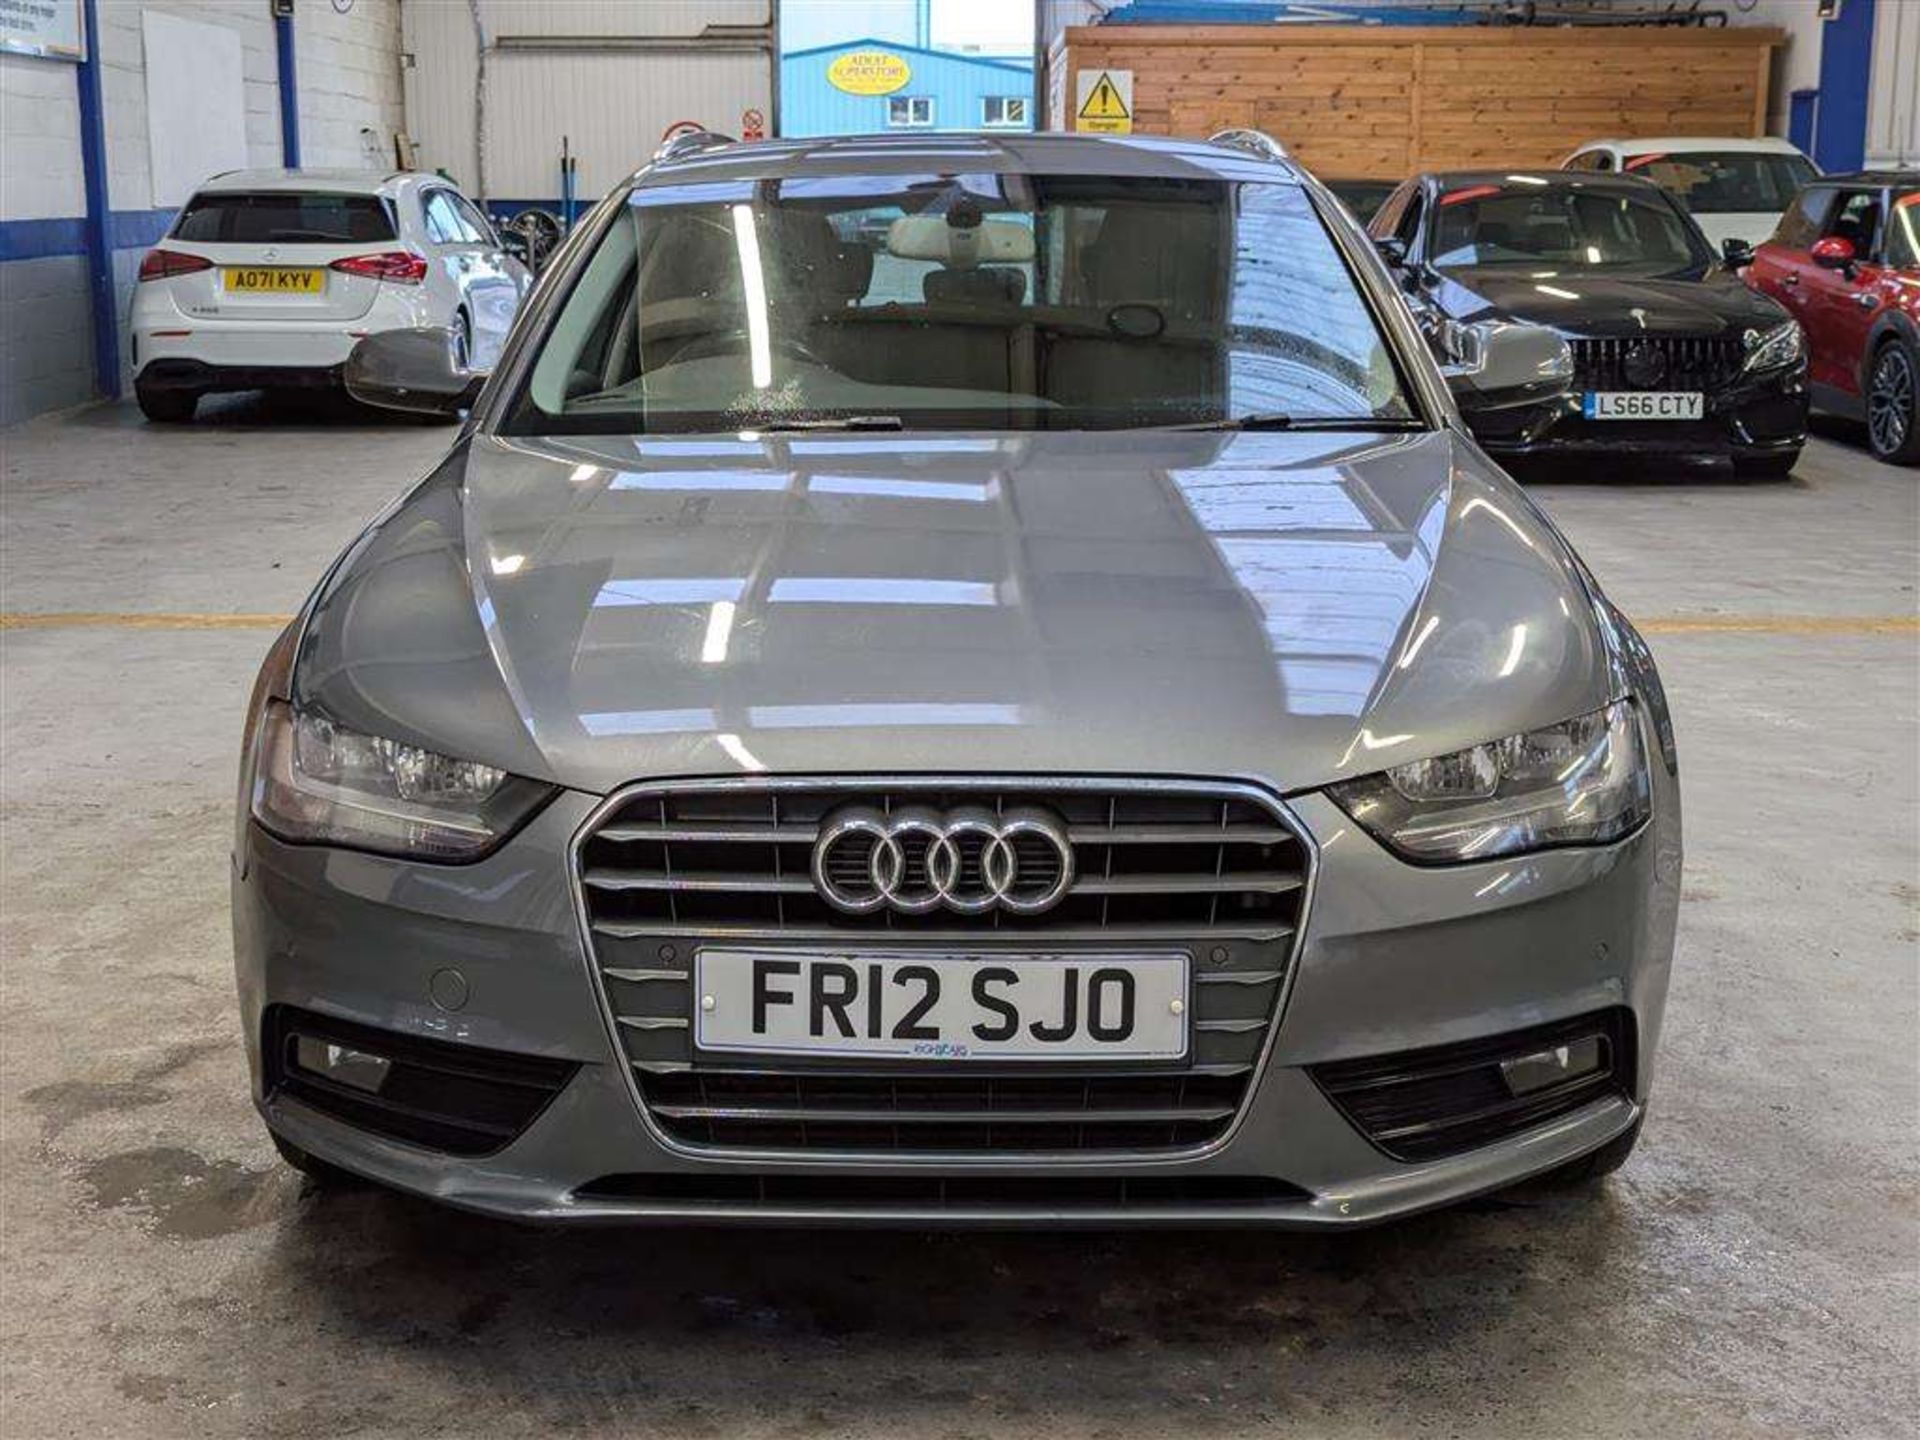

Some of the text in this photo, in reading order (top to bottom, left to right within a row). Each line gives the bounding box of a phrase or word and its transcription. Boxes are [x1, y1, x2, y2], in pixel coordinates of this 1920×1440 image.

[235, 271, 312, 288] AO71 KYV
[1600, 396, 1699, 415] LS66 CTY
[753, 960, 1136, 1043] FR12 SJO
